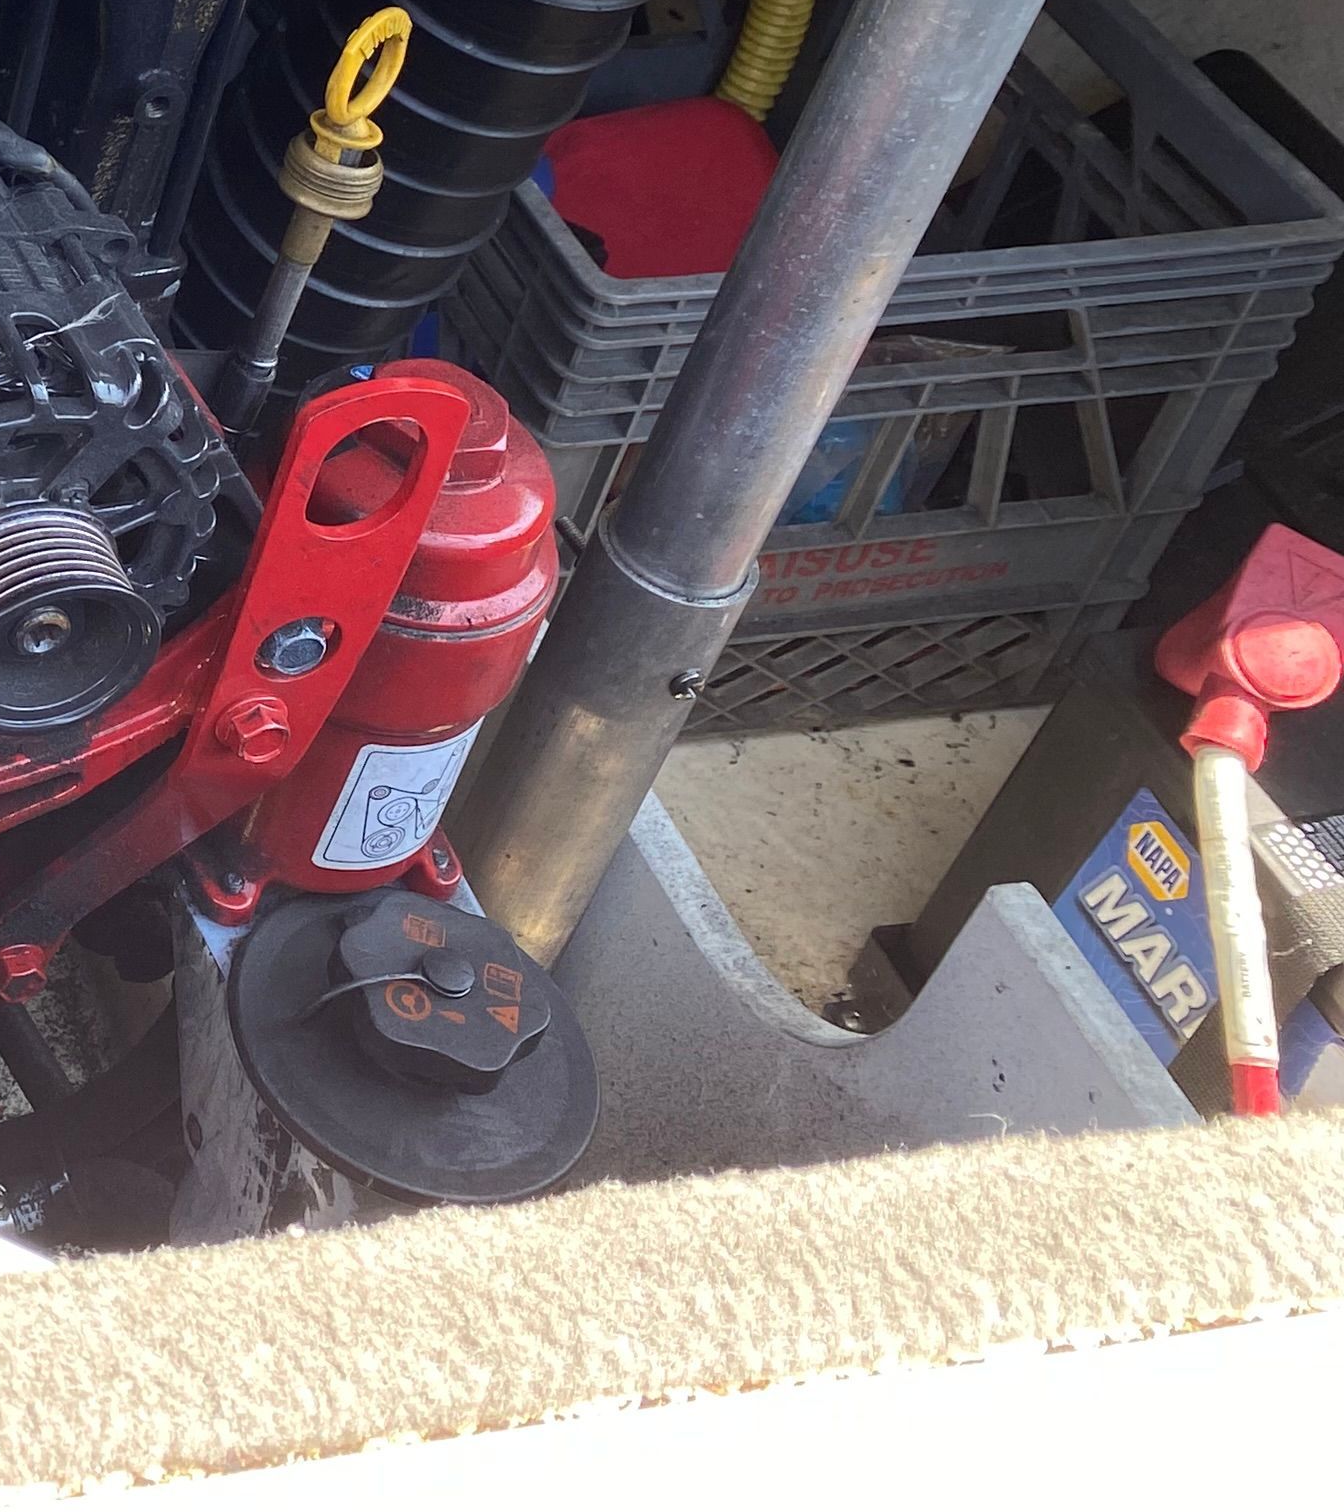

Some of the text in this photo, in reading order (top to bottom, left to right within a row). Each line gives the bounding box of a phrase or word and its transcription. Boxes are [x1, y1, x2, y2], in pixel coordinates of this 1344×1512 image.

[761, 561, 1009, 605] TO PROSECUTION
[1134, 830, 1183, 893] NAPA
